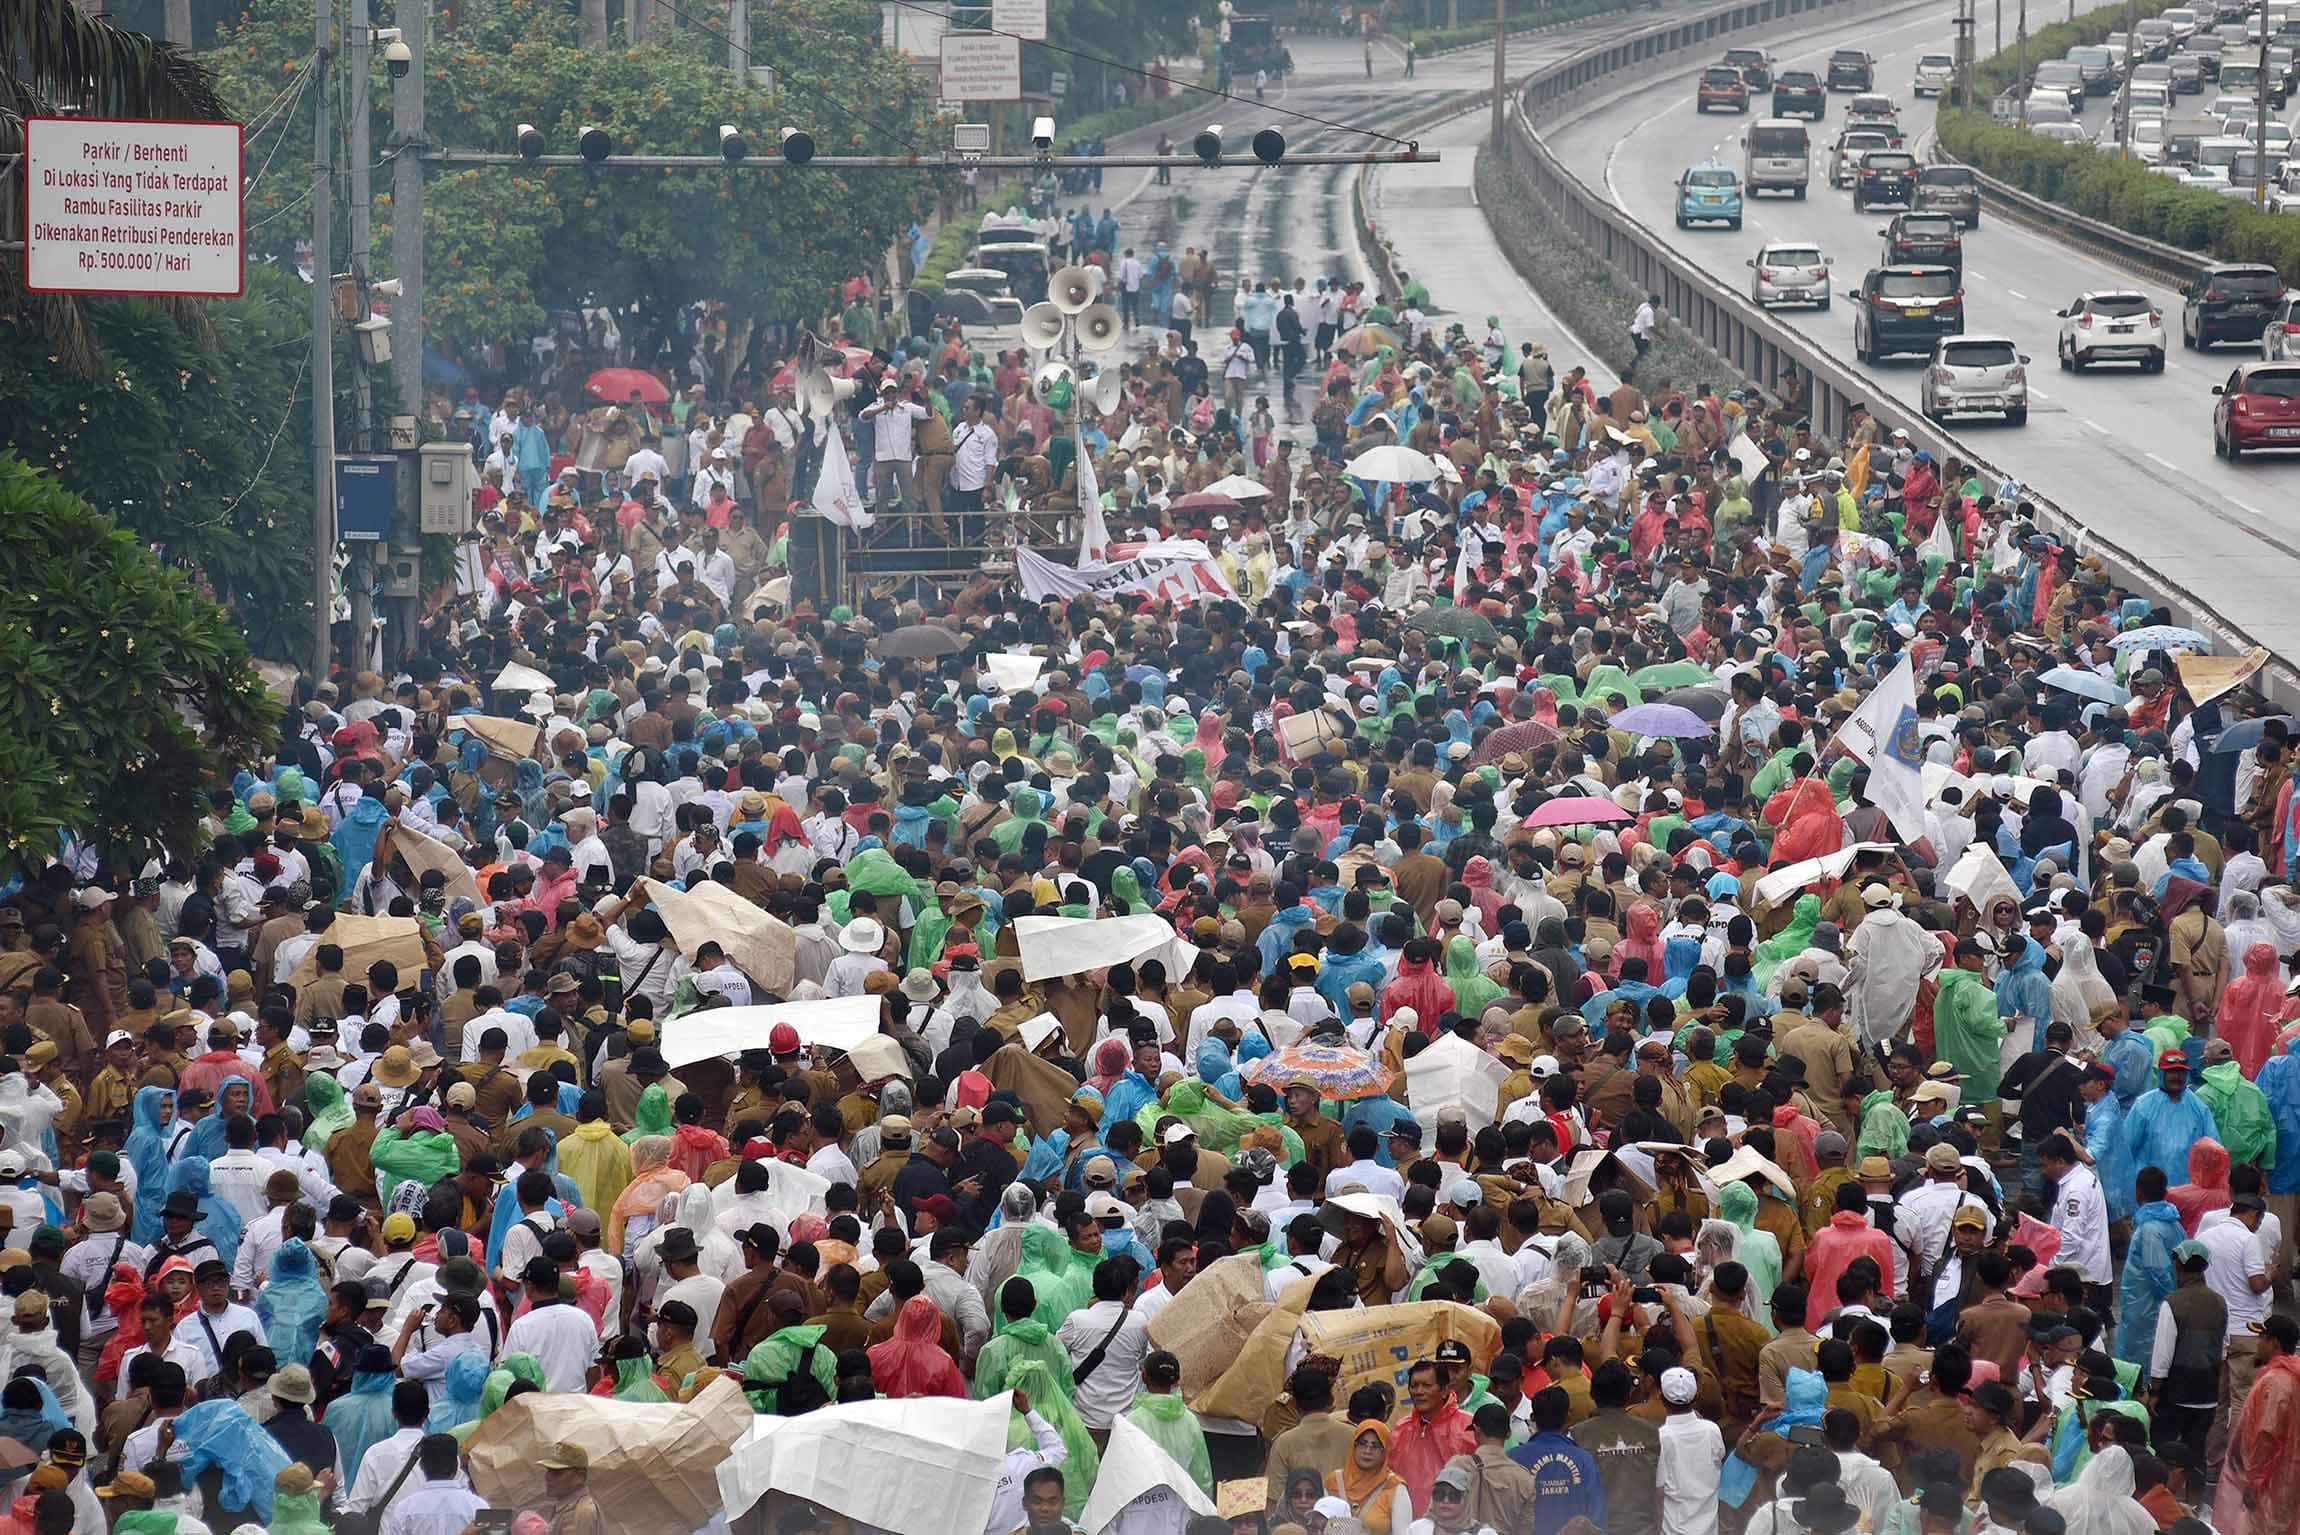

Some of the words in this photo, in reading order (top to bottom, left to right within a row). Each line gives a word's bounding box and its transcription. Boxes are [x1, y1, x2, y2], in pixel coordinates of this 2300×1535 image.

[83, 142, 120, 161] Parkir
[124, 144, 130, 163] /
[134, 143, 188, 162] Berhenti
[44, 169, 56, 186] Di
[59, 170, 98, 188] Lokasi
[103, 171, 132, 192] Yang
[136, 172, 169, 190] Tidak
[173, 173, 228, 195] Terdapat
[64, 197, 105, 215] Rambu
[109, 199, 162, 217] Fasilitas
[165, 200, 202, 218] Parkir
[35, 223, 98, 242] Dikenakan
[102, 225, 157, 244] Retribusi
[161, 228, 234, 246] Penderekan
[79, 251, 97, 272] Rp.
[101, 252, 152, 270] 500.000
[155, 254, 162, 272] /
[165, 254, 191, 271] Hari
